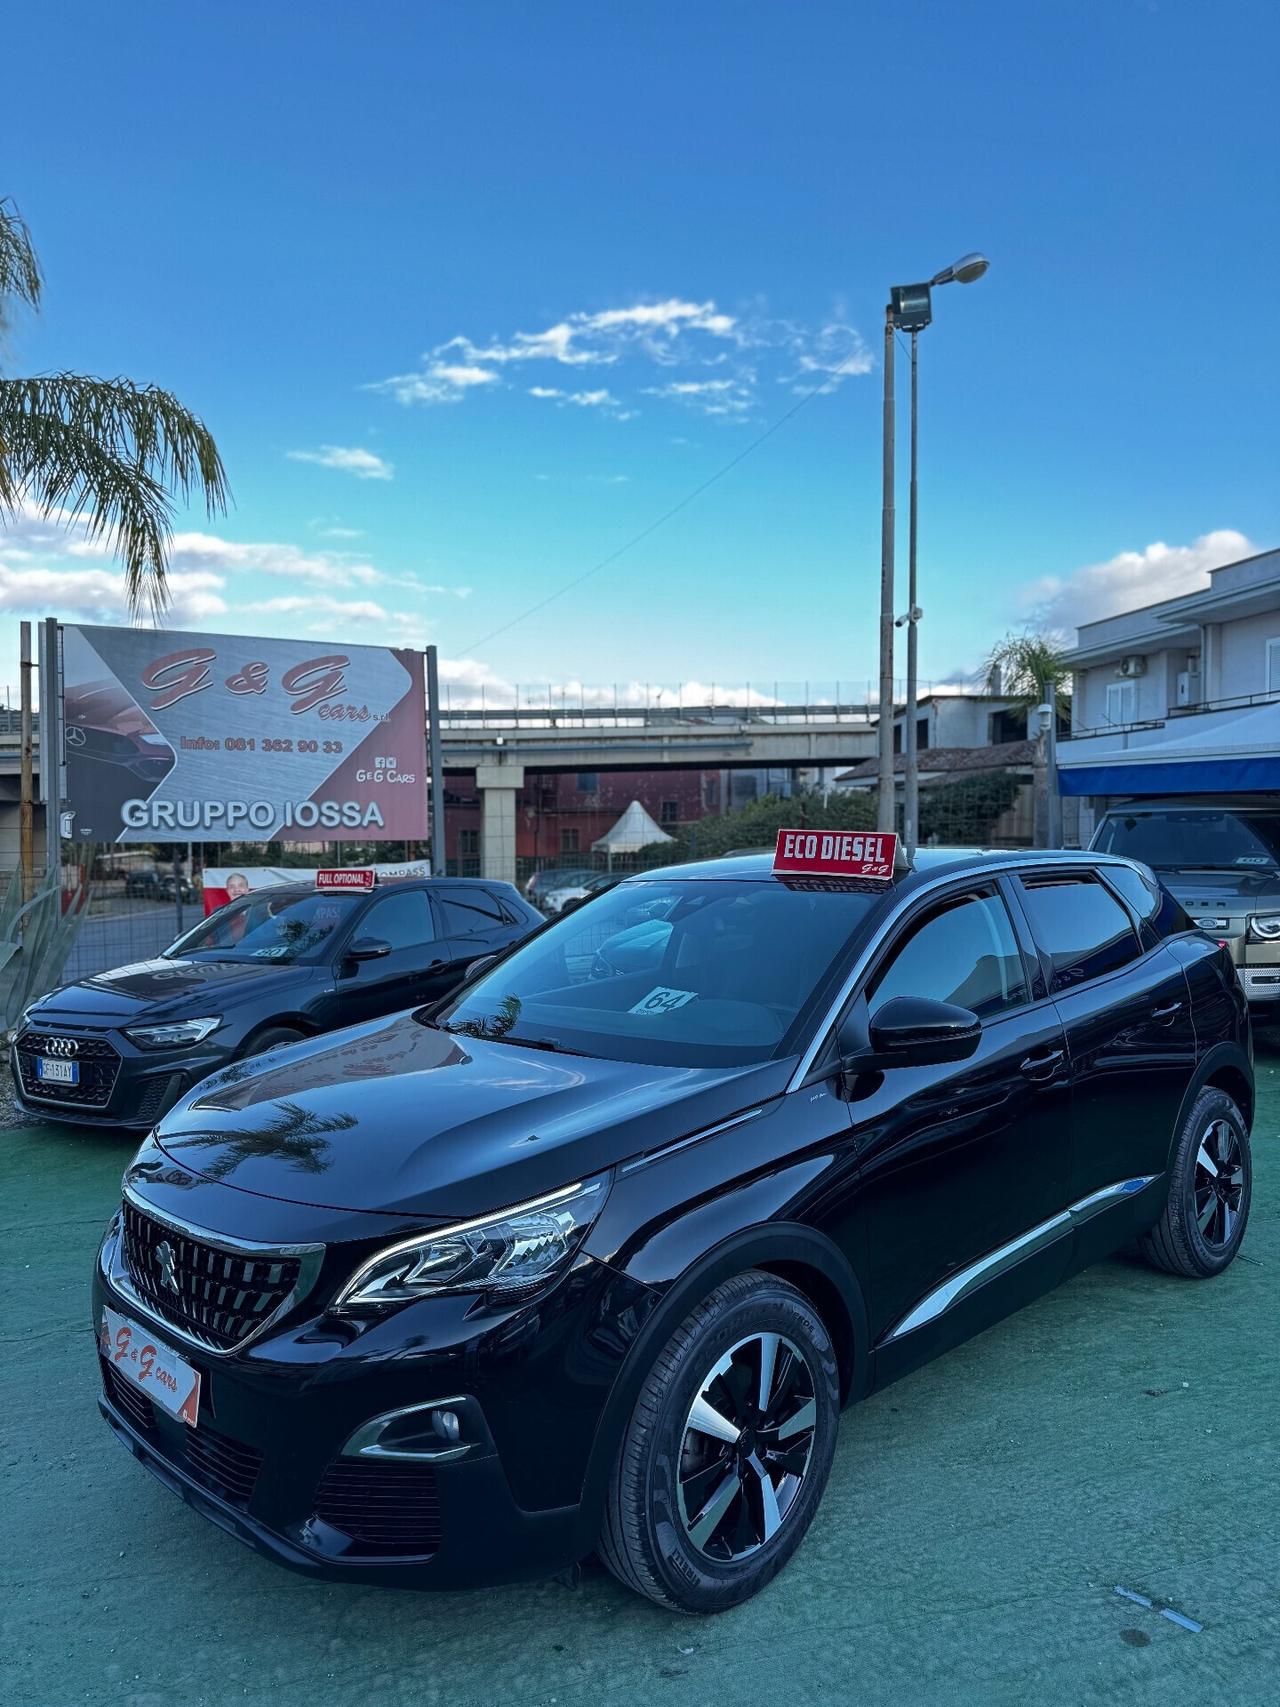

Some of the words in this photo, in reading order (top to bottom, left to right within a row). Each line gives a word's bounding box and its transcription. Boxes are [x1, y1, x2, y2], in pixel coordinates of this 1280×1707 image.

[142, 648, 216, 711] G
[224, 661, 270, 695] &
[281, 655, 350, 715] G
[319, 703, 372, 722] cars
[180, 736, 220, 750] Info:
[224, 737, 255, 751] 081
[297, 739, 319, 753] 90
[322, 741, 343, 753] 33
[121, 799, 275, 828] GRUPPO
[284, 800, 385, 828] IOSSA
[783, 834, 818, 859] ECO
[820, 835, 885, 863] DIESEL
[318, 873, 333, 884] FULL
[333, 873, 364, 884] OPTIONAL
